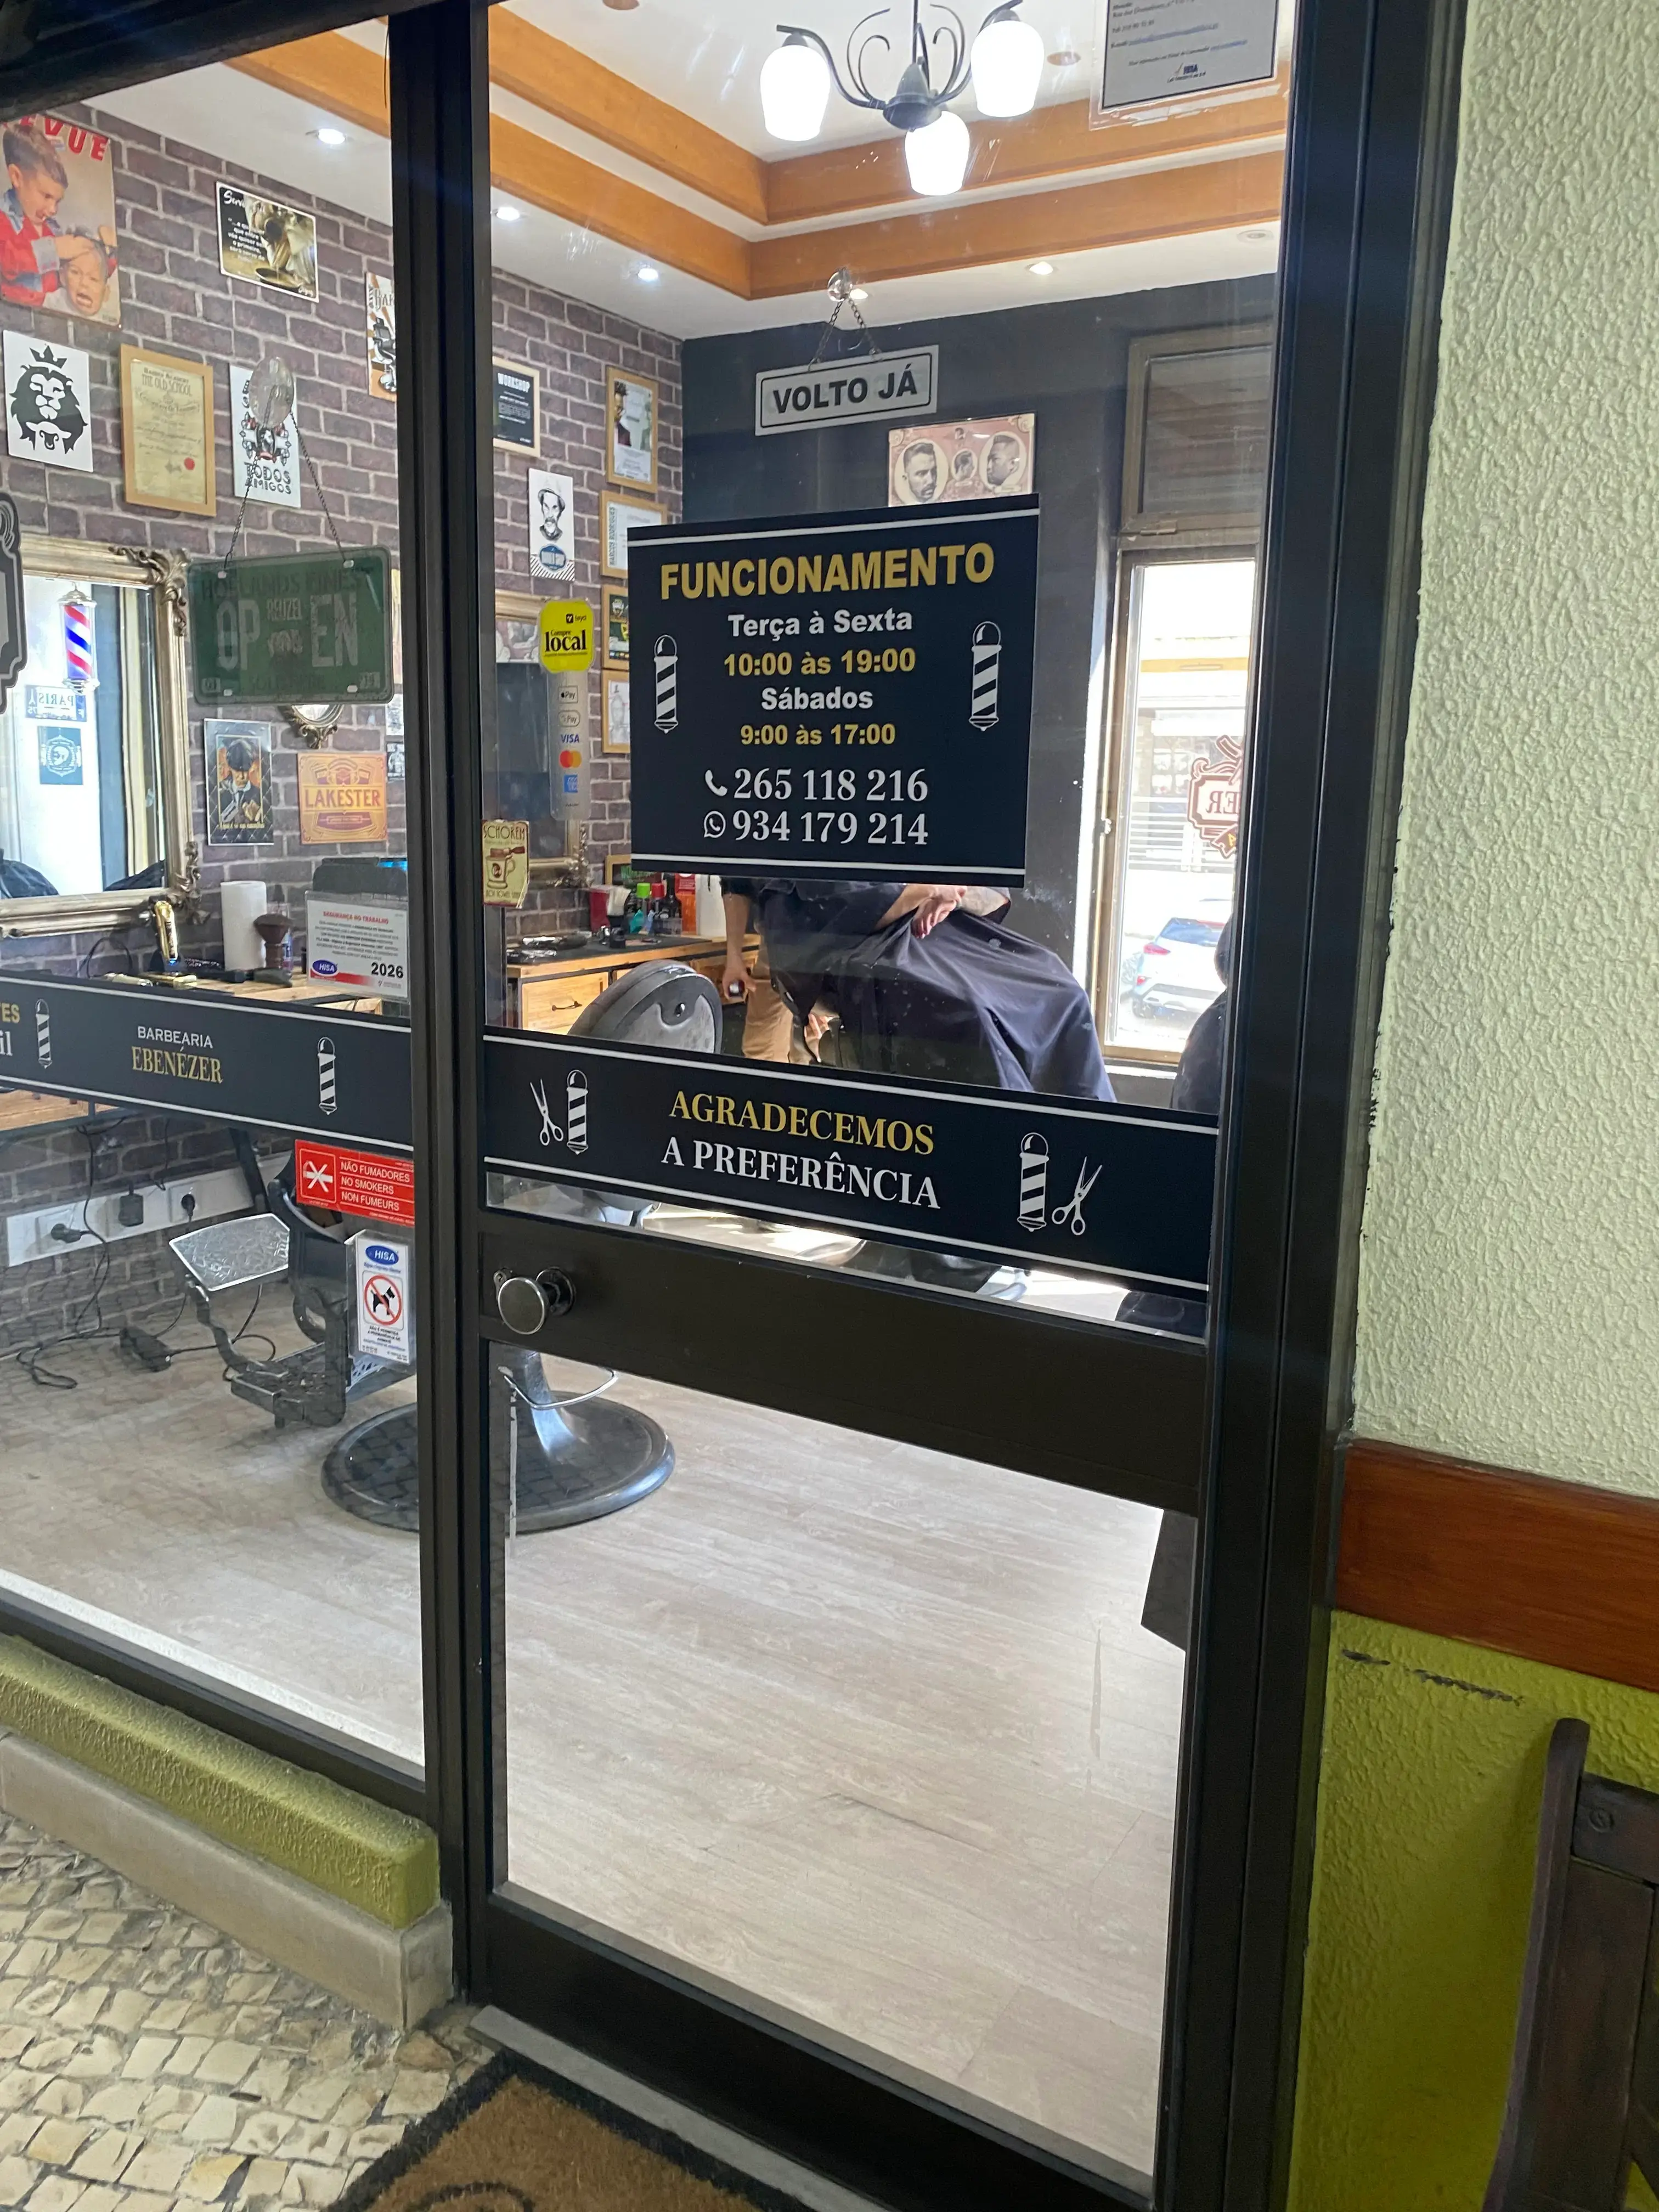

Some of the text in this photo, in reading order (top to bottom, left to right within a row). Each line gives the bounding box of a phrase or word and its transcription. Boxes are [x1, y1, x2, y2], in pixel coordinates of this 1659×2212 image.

[774, 362, 917, 413] VOLTO JÁ
[661, 542, 995, 600] FUNCIONAMENTO
[727, 607, 912, 641] Terça à Sexta
[545, 629, 586, 652] local
[724, 648, 916, 676] 10:00 às 19:00
[761, 686, 873, 710] Sábados
[561, 734, 580, 743] VISA
[741, 724, 895, 745] 9:00 às 17:00
[734, 768, 928, 802] 265 118 216
[305, 789, 381, 808] LAKESTER
[483, 826, 525, 841] SCHOREM
[732, 810, 928, 845] 934 179 214
[319, 963, 335, 972] HISA
[371, 962, 403, 978] 2026
[0, 1003, 20, 1024] ES
[138, 1026, 213, 1049] BARBEARIA
[132, 1045, 223, 1084] EBENÉZER
[669, 1091, 934, 1155] AGRADECEMOS
[341, 1161, 358, 1173] NÃO
[359, 1164, 410, 1183] FUMADORES
[661, 1137, 941, 1209] A PREFERÊNCIA
[341, 1176, 394, 1195] NO SMOKERS
[341, 1192, 399, 1211] NON FUMEURS
[375, 1250, 395, 1262] HISA
